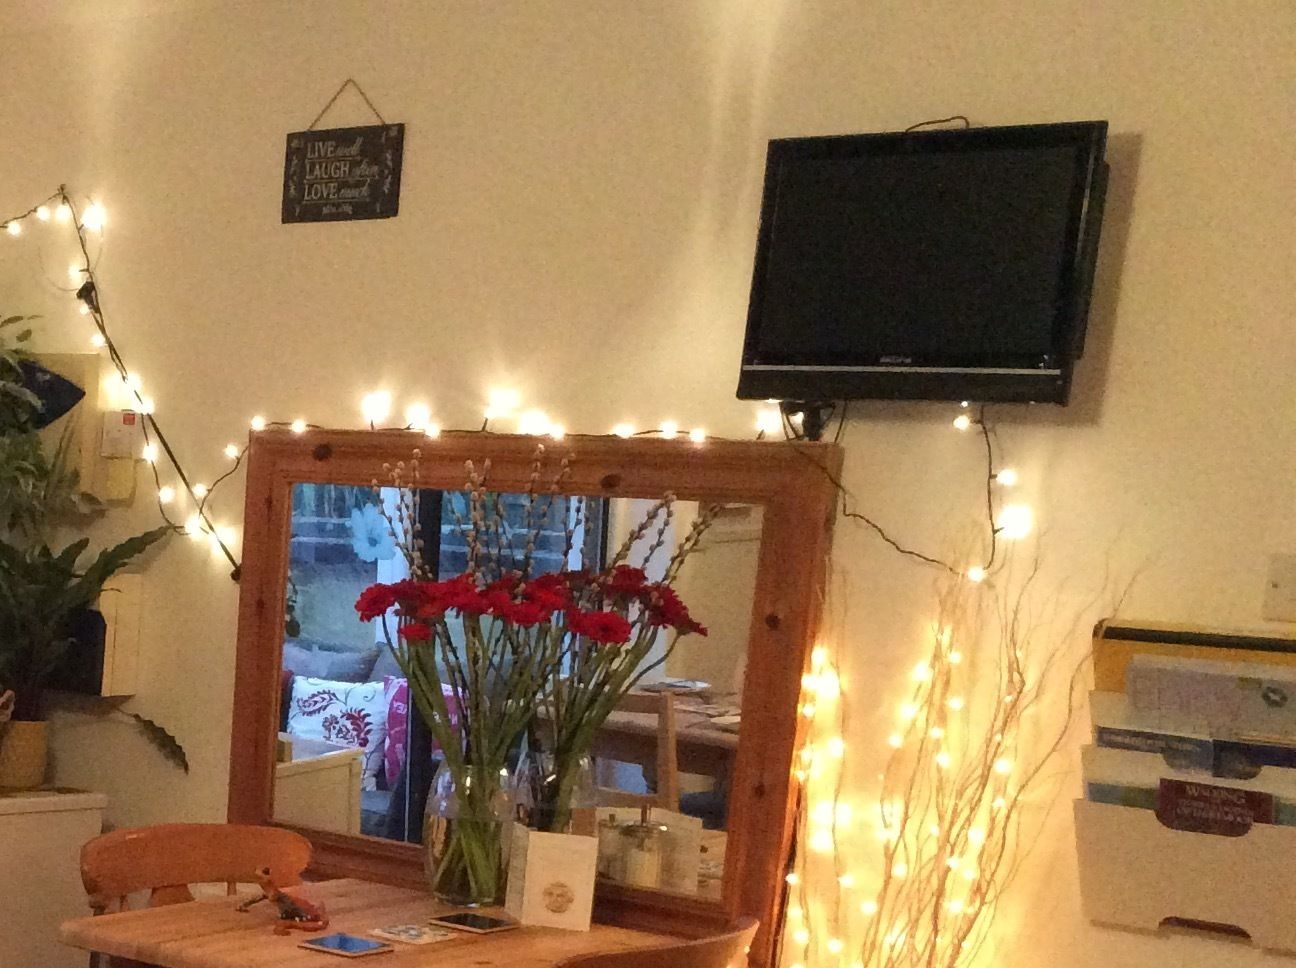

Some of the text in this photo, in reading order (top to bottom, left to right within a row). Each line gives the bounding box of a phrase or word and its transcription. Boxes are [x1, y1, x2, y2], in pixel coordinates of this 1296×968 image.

[306, 141, 336, 159] LIVE
[305, 161, 350, 180] LAUGH
[304, 182, 338, 200] LOVE
